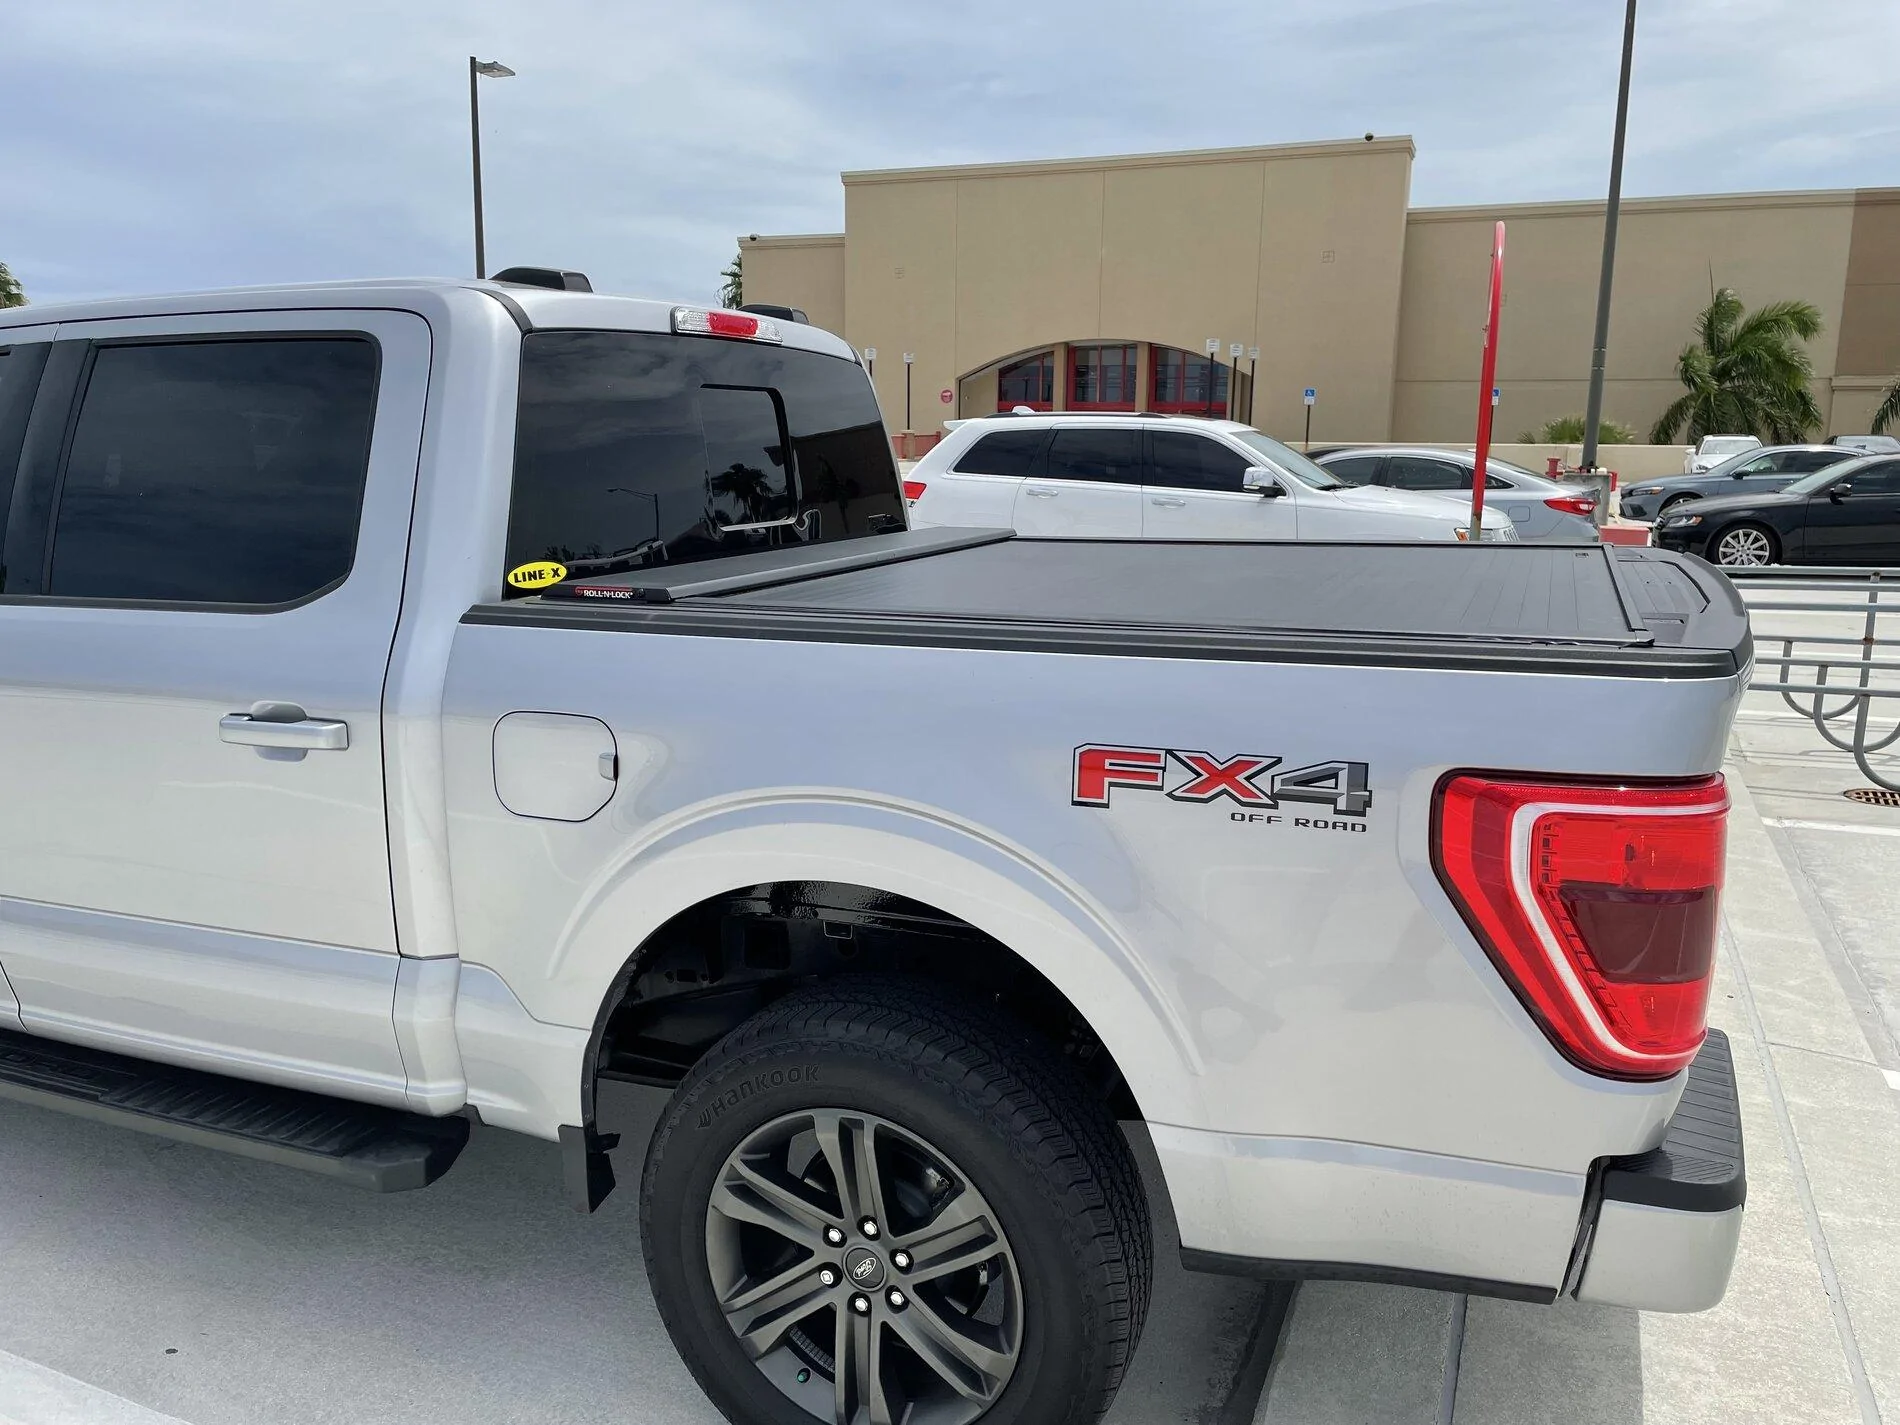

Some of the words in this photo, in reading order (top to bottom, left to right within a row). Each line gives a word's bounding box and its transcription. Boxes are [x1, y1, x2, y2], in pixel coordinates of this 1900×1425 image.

[514, 567, 561, 583] LINE-X
[1071, 742, 1372, 818] FX4
[1230, 812, 1282, 824] OFF
[1295, 818, 1367, 833] ROAD
